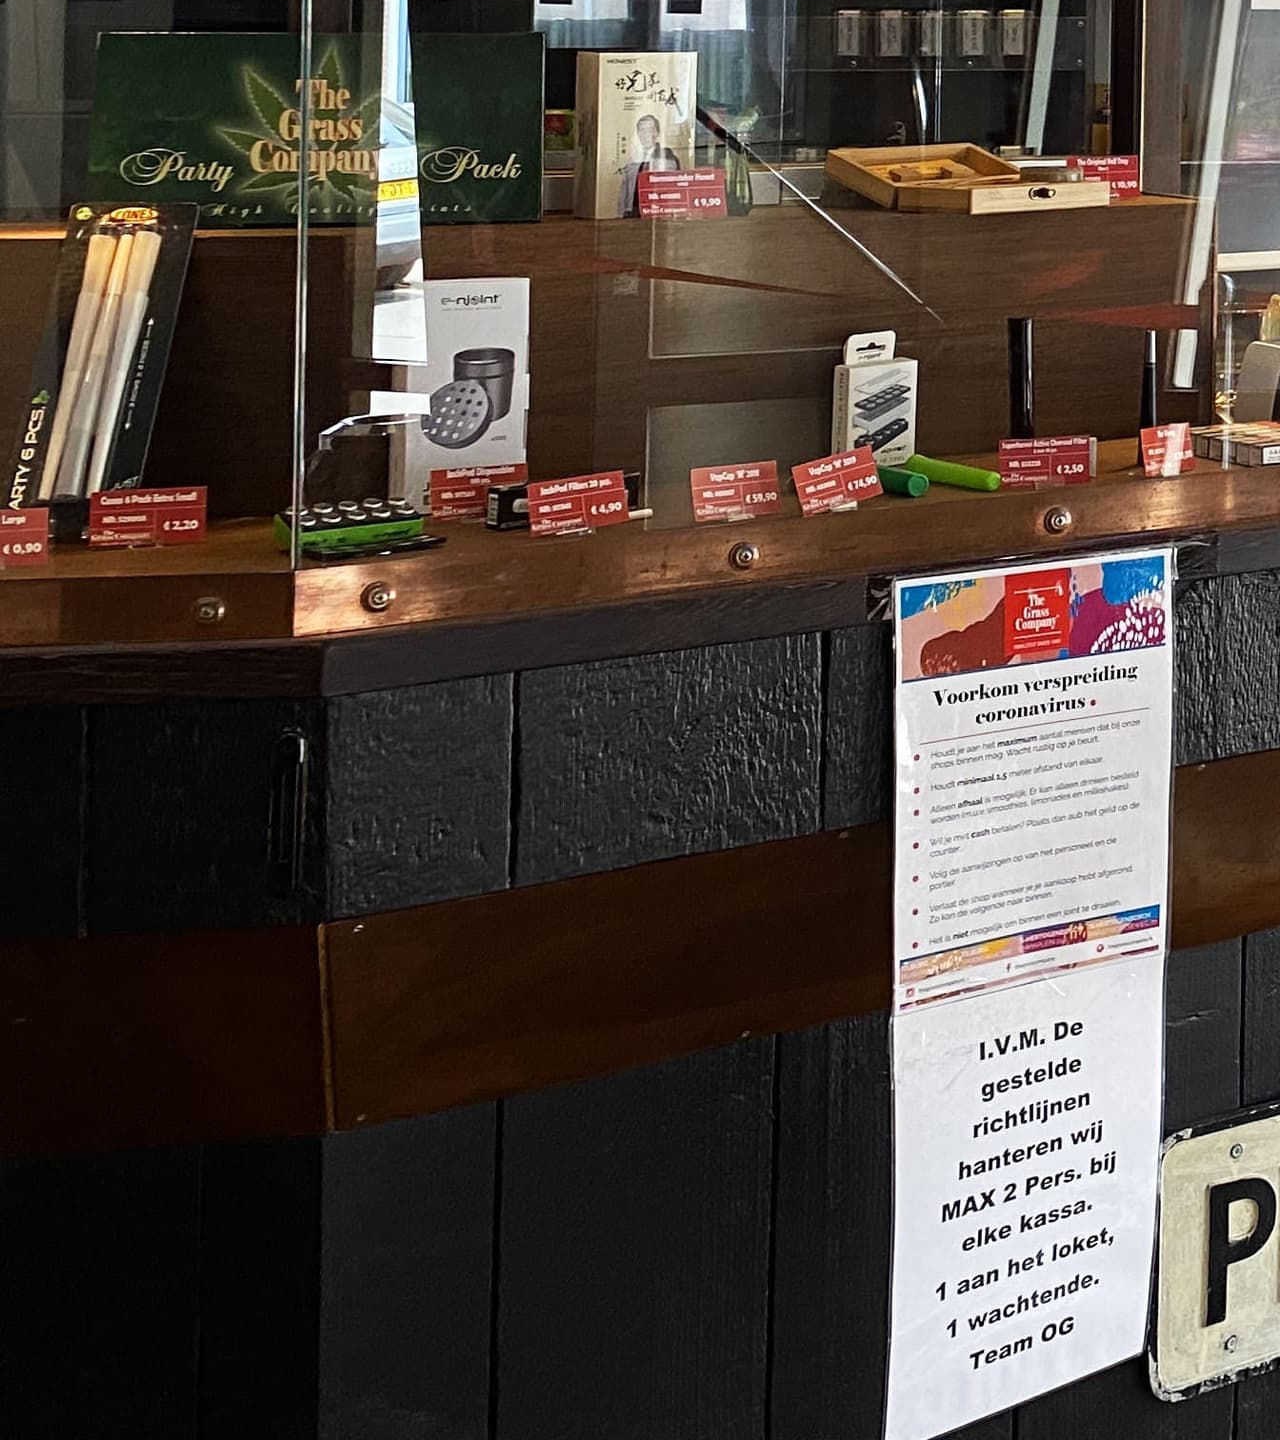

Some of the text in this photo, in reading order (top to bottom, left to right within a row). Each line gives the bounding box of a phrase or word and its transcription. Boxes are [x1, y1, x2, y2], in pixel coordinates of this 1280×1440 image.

[295, 79, 351, 111] The
[277, 110, 364, 142] Grass
[119, 145, 522, 193] Party Pack
[249, 140, 386, 183] Company
[8, 465, 31, 510] ARTY
[21, 448, 35, 459] 6
[848, 482, 854, 491] €
[854, 475, 877, 490] 74,90
[1057, 464, 1084, 474] € 2,50
[591, 502, 622, 515] € 4,90
[746, 494, 751, 504] €
[751, 492, 777, 502] 59,90
[163, 519, 199, 532] € 2,20
[3, 542, 42, 555] € 0,90
[1023, 606, 1050, 619] Grass
[1028, 593, 1045, 607] The
[1015, 617, 1057, 632] Company
[933, 664, 1139, 707] Voorkom verspreiding
[997, 734, 1038, 747] maximum
[957, 773, 995, 787] minimaal
[957, 796, 983, 809] afhaal
[971, 827, 991, 839] cash
[952, 929, 969, 941] niet
[979, 1021, 1084, 1061] I.V.M. De
[981, 1057, 1082, 1103] gestelde
[972, 1092, 1091, 1139] richtlijnen
[958, 1120, 1103, 1181] hanteren wij
[941, 1151, 1116, 1222] MAX 2 Pers. bij
[962, 1199, 1093, 1251] elke kassa.
[935, 1227, 1114, 1301] 1 aan het loket,
[946, 1274, 1099, 1338] 1 wachtende.
[969, 1316, 1074, 1370] Team OG
